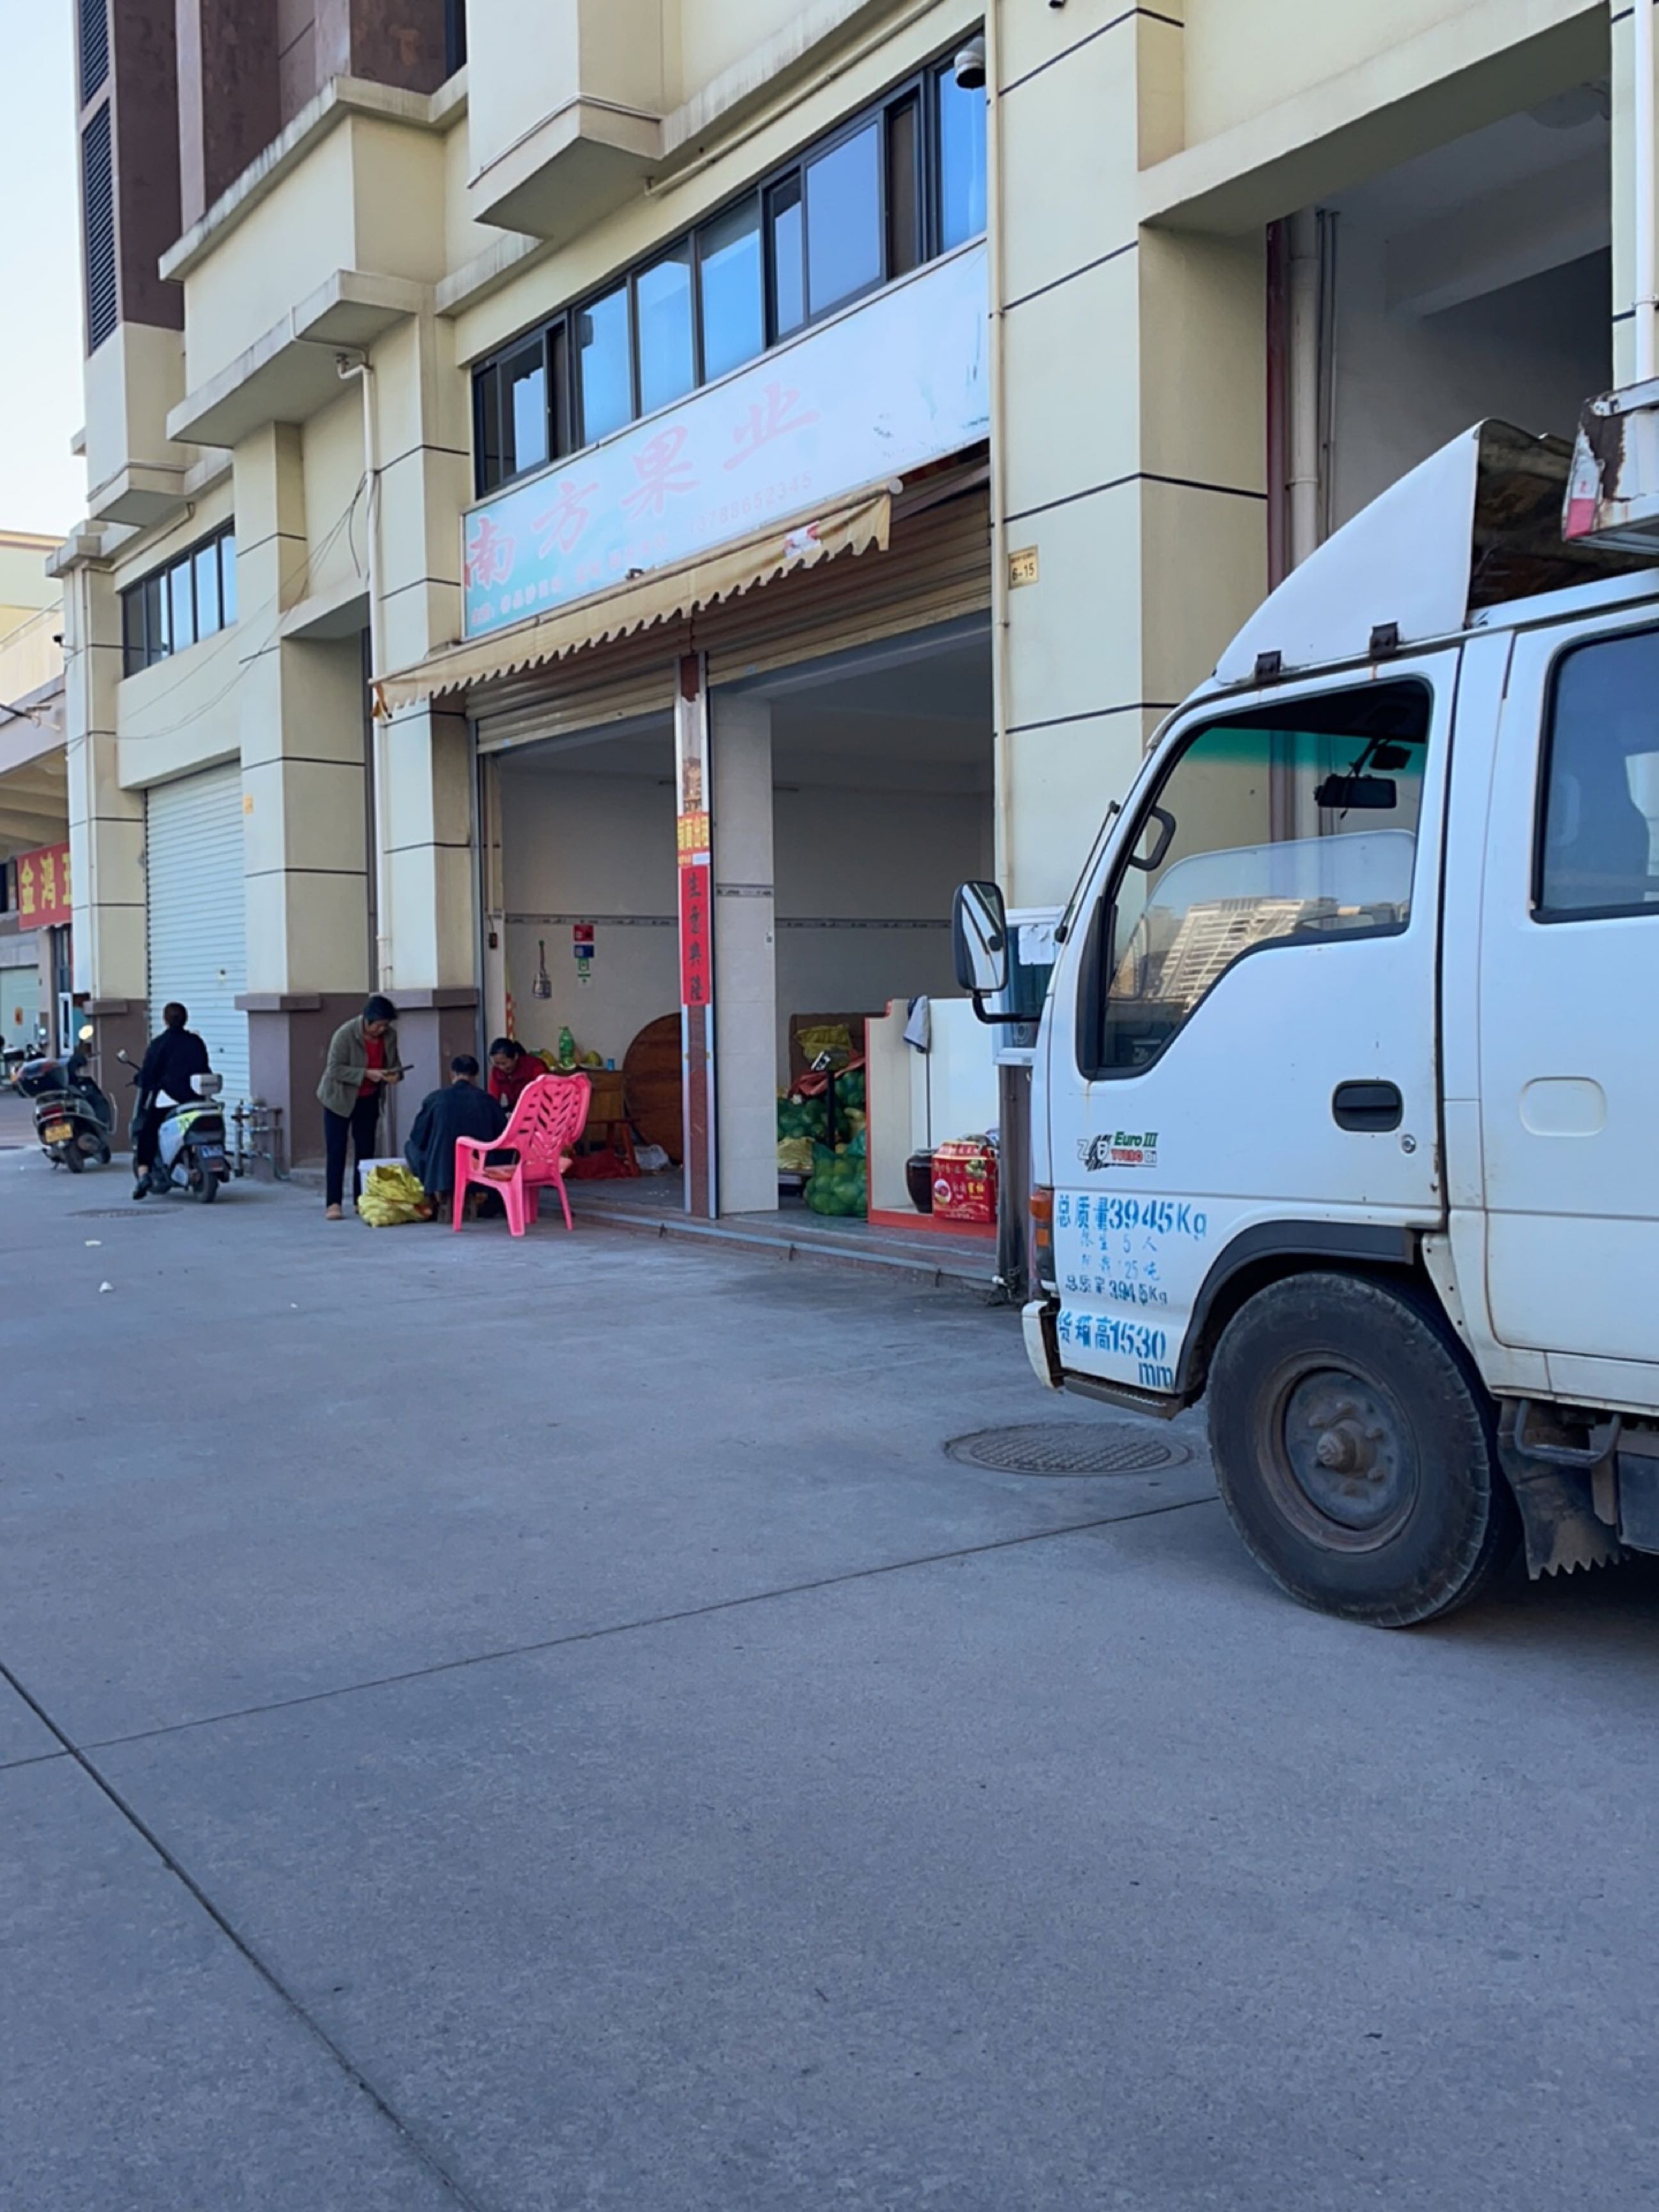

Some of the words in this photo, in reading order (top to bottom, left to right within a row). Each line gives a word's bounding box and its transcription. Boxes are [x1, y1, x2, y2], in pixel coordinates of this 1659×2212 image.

[464, 383, 821, 591] 南方果业
[1114, 1131, 1142, 1146] Euro
[1139, 1363, 1173, 1390] mm
